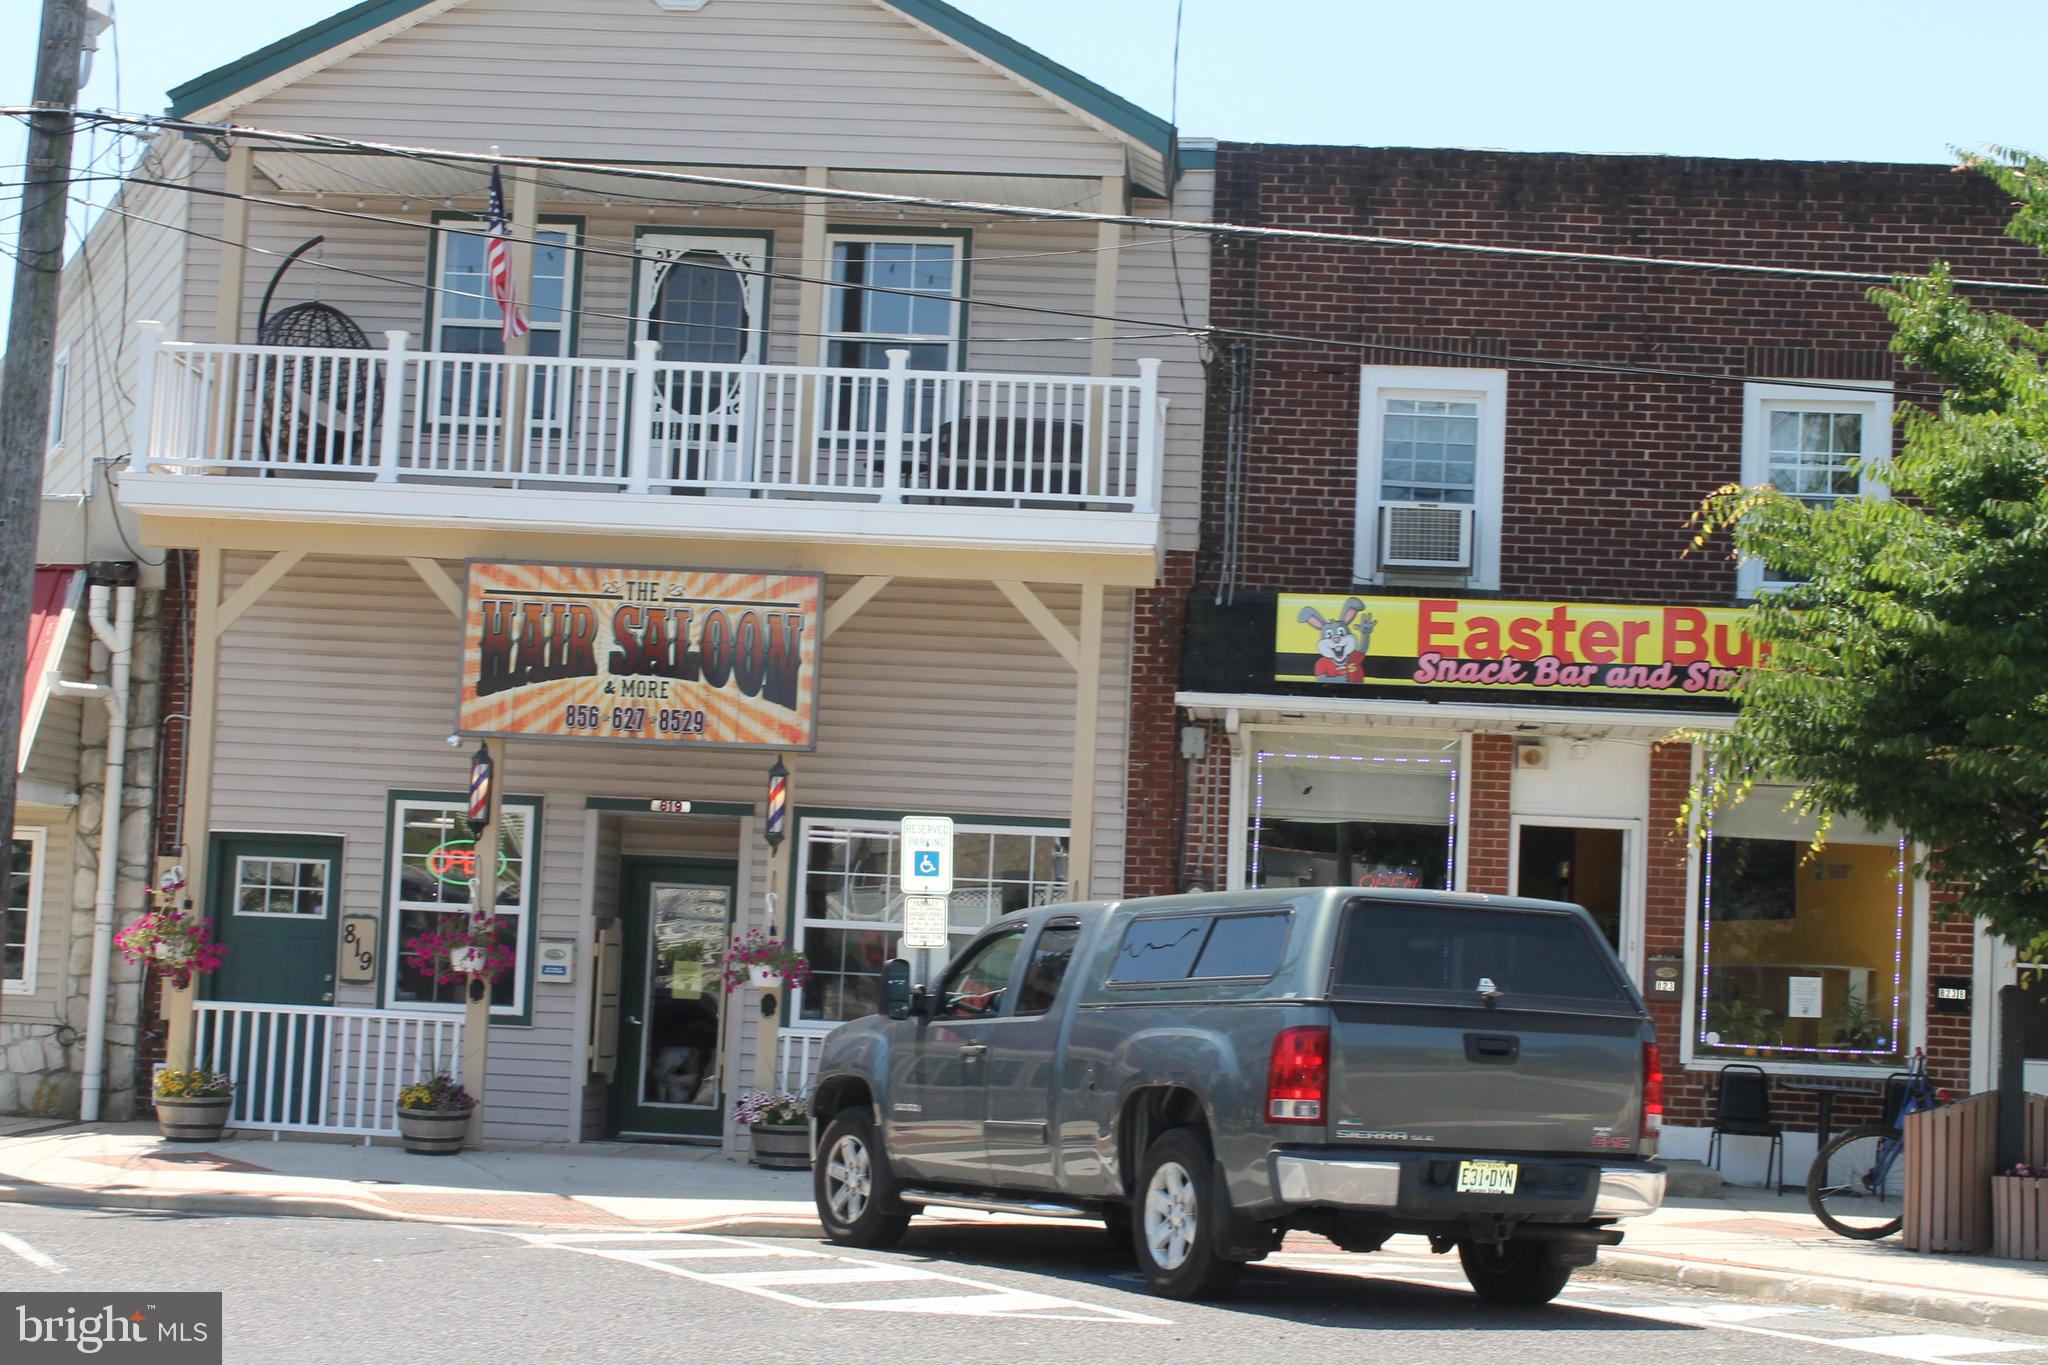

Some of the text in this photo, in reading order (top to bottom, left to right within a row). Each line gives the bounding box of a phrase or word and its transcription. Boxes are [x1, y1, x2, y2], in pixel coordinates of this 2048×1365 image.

[626, 581, 659, 602] THE
[1417, 599, 1650, 665] Easter
[476, 600, 805, 711] HAIR SALOON
[1412, 651, 1529, 683] Snack
[1532, 656, 1600, 687] Bar
[1605, 660, 1678, 690] and
[603, 679, 671, 700] & MORE
[565, 704, 705, 733] 856 627 8529
[659, 801, 683, 812] 819
[905, 824, 949, 835] RESERVED
[908, 837, 947, 848] PARKING
[430, 849, 477, 875] OPE
[1358, 871, 1419, 889] OPEN
[343, 923, 372, 971] 819
[1336, 1129, 1408, 1140] SIERRA
[1591, 1136, 1632, 1149] GMC
